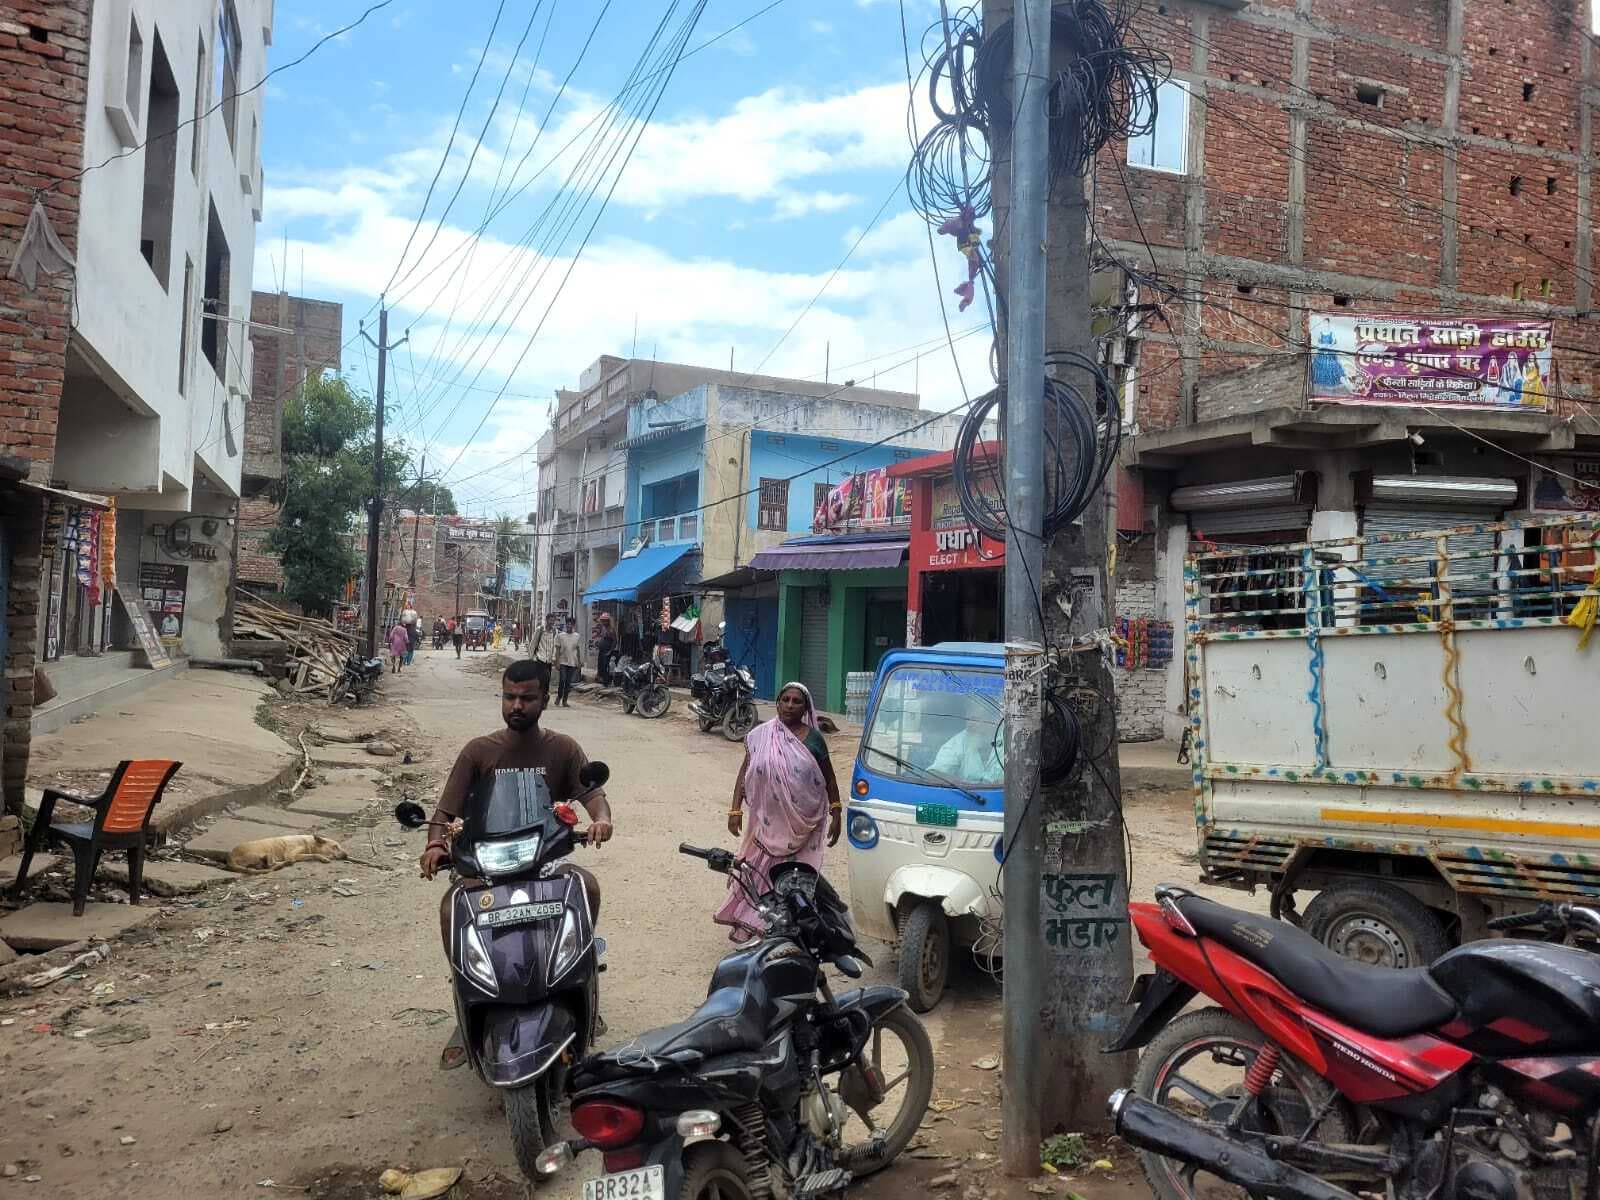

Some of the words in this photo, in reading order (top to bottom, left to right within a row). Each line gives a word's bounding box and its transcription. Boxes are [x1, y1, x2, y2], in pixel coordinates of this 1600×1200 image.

[1356, 324, 1422, 347] प्रधान
[1429, 323, 1483, 351] साड़ी
[1490, 328, 1549, 349] हाउस
[1456, 354, 1482, 371] घर
[1042, 873, 1118, 912] फूल
[1333, 1041, 1361, 1061] HERO
[1360, 1057, 1396, 1082] HONDA
